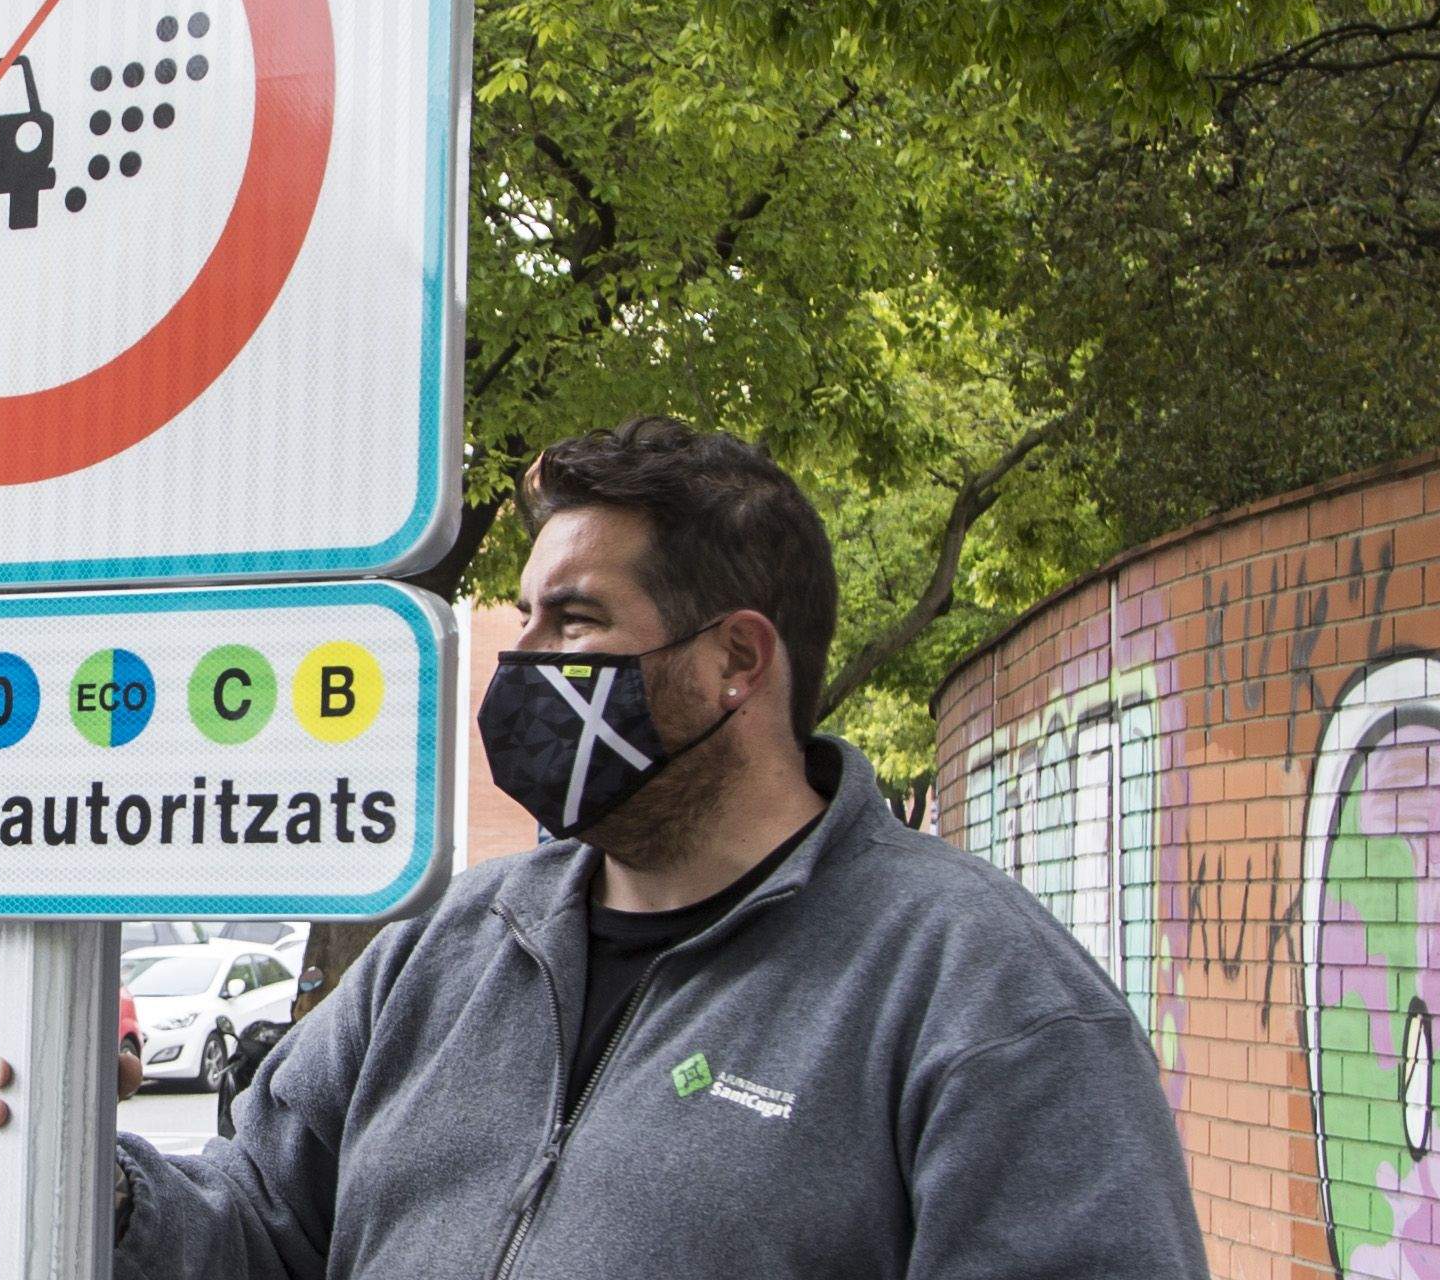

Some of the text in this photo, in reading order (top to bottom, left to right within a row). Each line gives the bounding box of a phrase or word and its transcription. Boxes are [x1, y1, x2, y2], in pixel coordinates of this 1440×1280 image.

[77, 682, 148, 714] ECO
[212, 666, 252, 721] C
[320, 665, 357, 718] B
[0, 776, 397, 846] autoritzats
